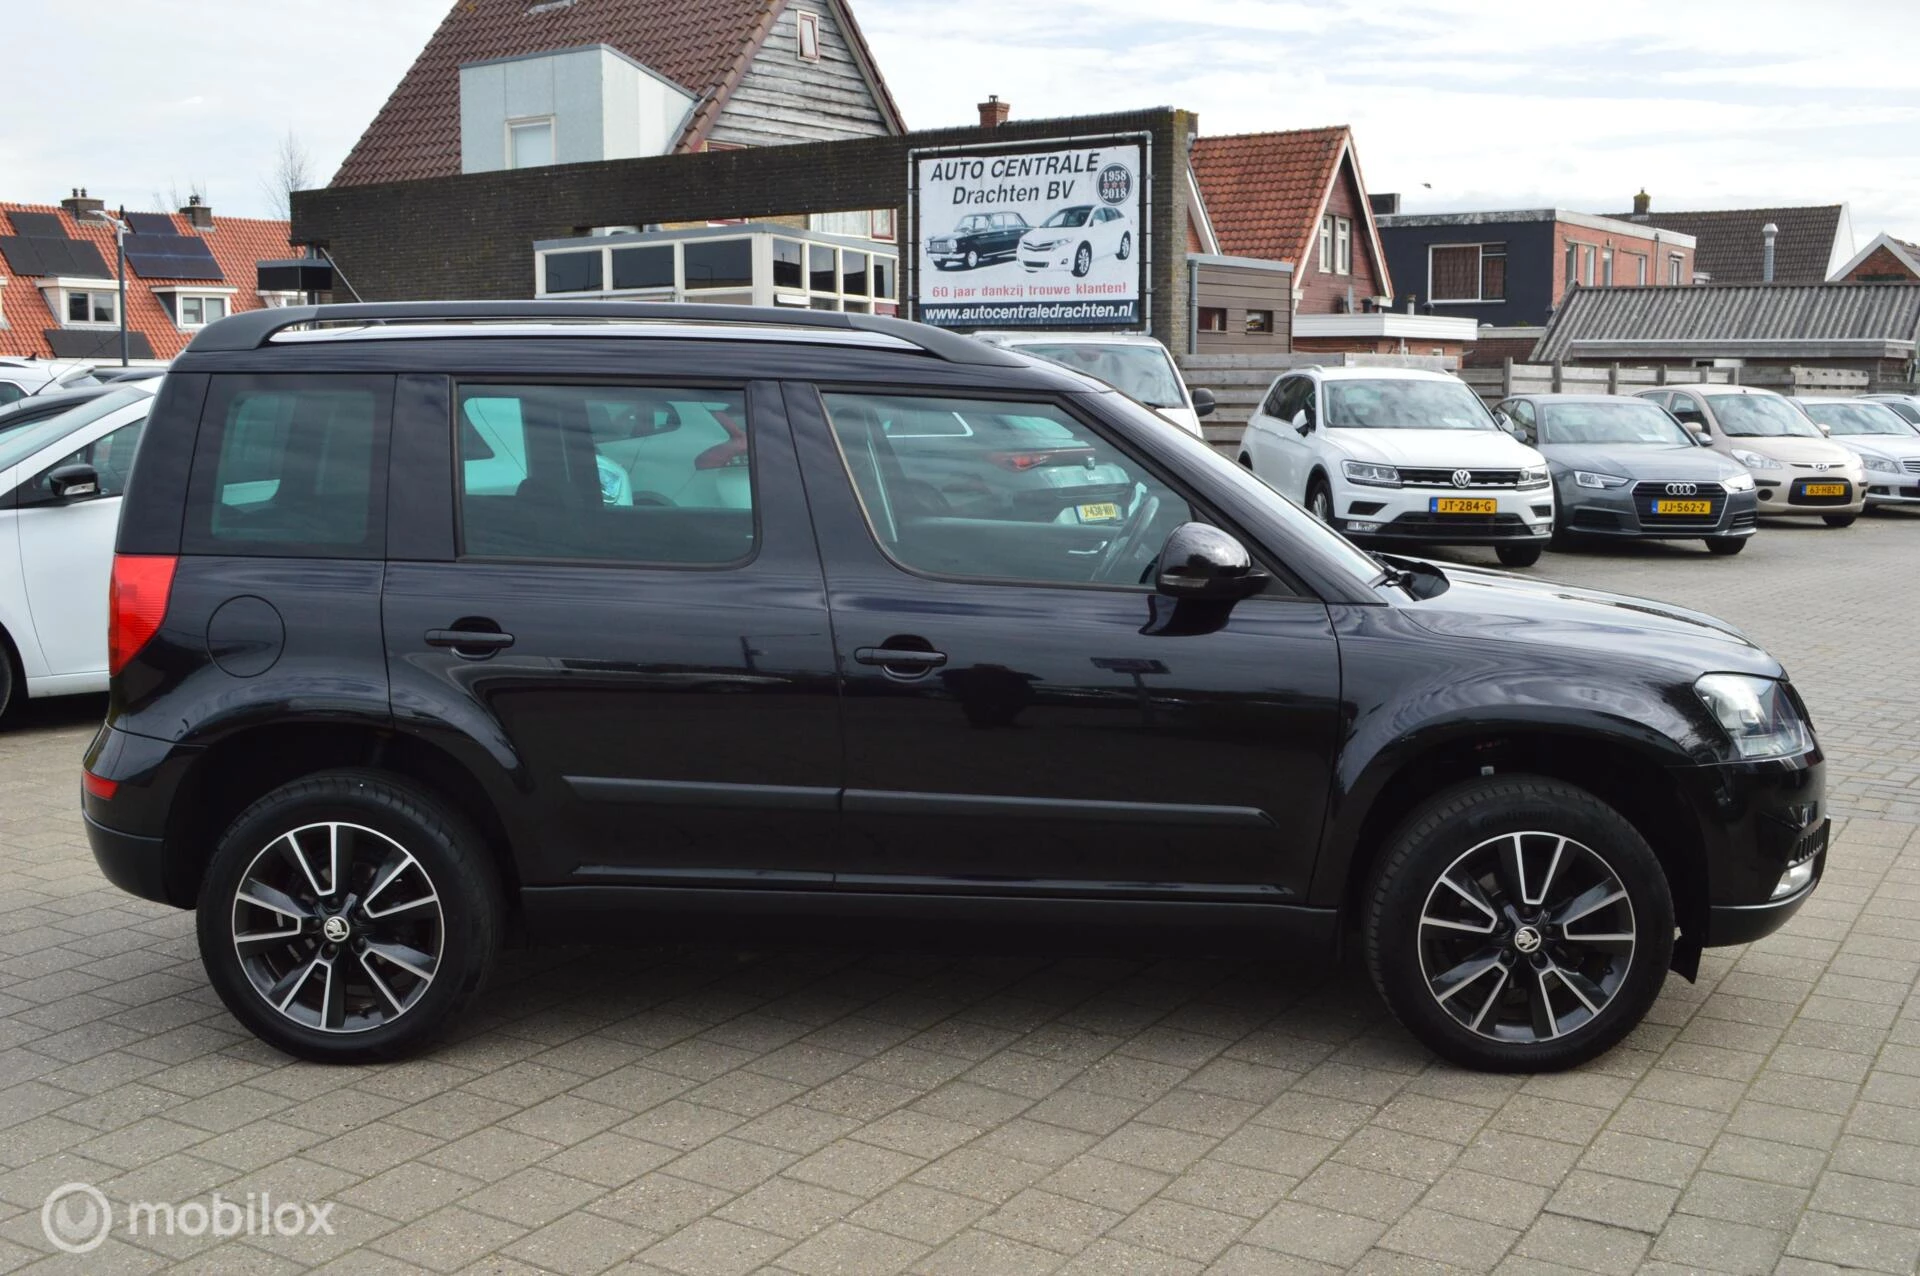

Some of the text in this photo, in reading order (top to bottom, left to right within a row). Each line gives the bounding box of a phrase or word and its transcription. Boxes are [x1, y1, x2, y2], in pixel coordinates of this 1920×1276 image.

[930, 152, 1100, 182] AUTO CENTRALE
[1103, 170, 1127, 181] 1958
[952, 180, 1075, 205] Drachten BV
[1102, 188, 1127, 199] 2018
[932, 282, 1127, 299] 60 jaar dankzij trouwe klanten!
[925, 301, 1134, 321] www.autocentraledrachten.nl
[1441, 501, 1492, 512] JT-284-G
[1661, 502, 1705, 512] JJ-562-Z
